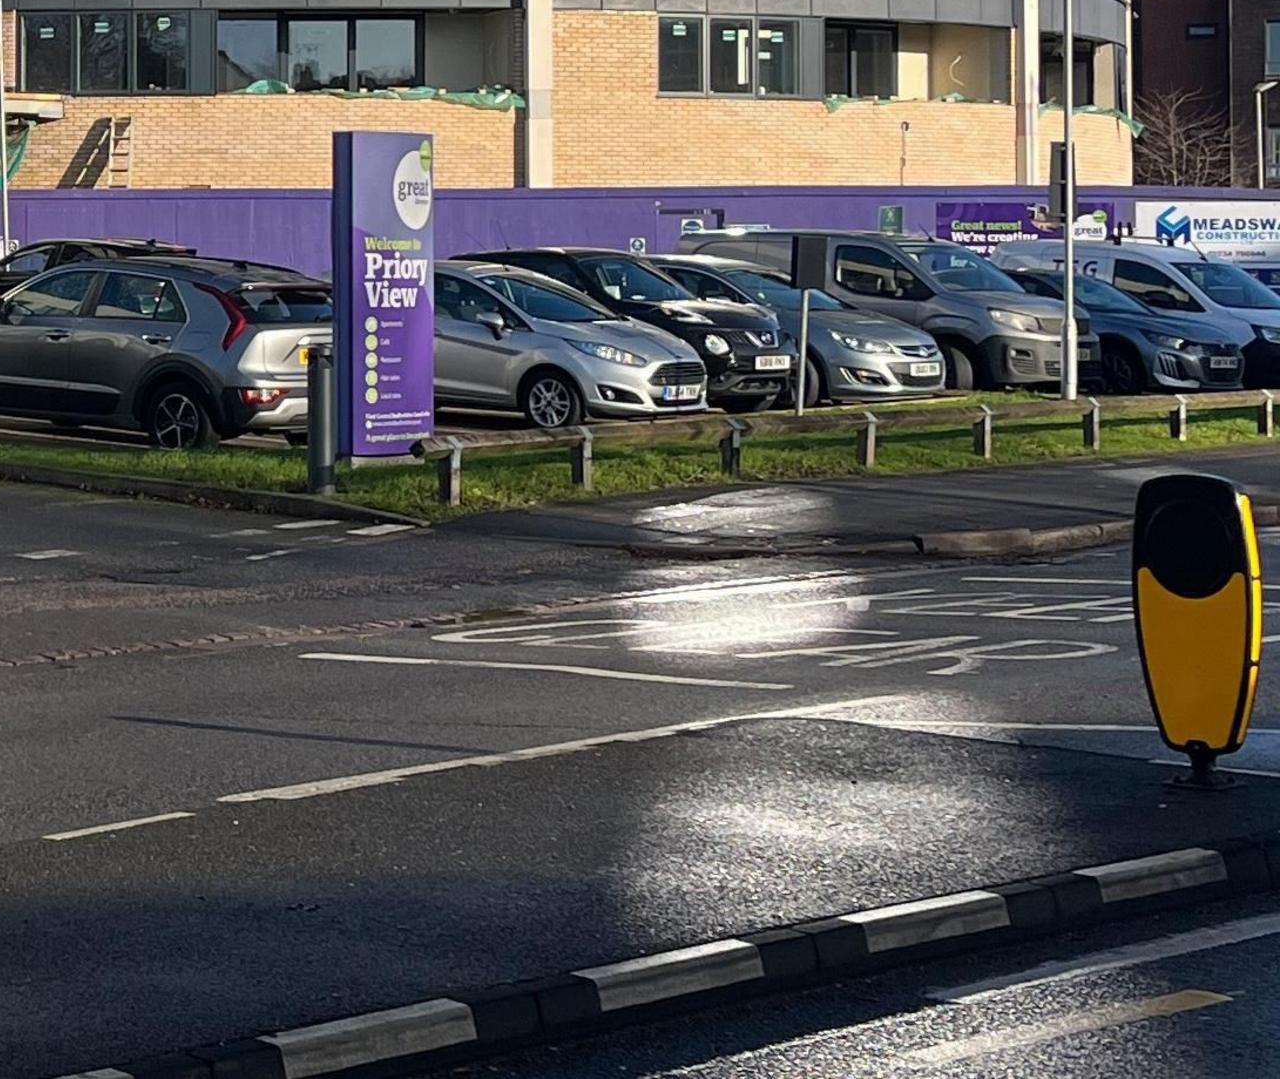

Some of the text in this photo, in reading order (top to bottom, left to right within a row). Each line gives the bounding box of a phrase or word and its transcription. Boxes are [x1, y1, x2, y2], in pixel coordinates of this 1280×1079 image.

[398, 179, 429, 201] great
[951, 220, 1022, 231] Great news!
[1074, 226, 1103, 237] great
[364, 236, 412, 251] Welcome
[951, 232, 986, 242] We're
[364, 251, 428, 286] Priory
[364, 280, 418, 308] View
